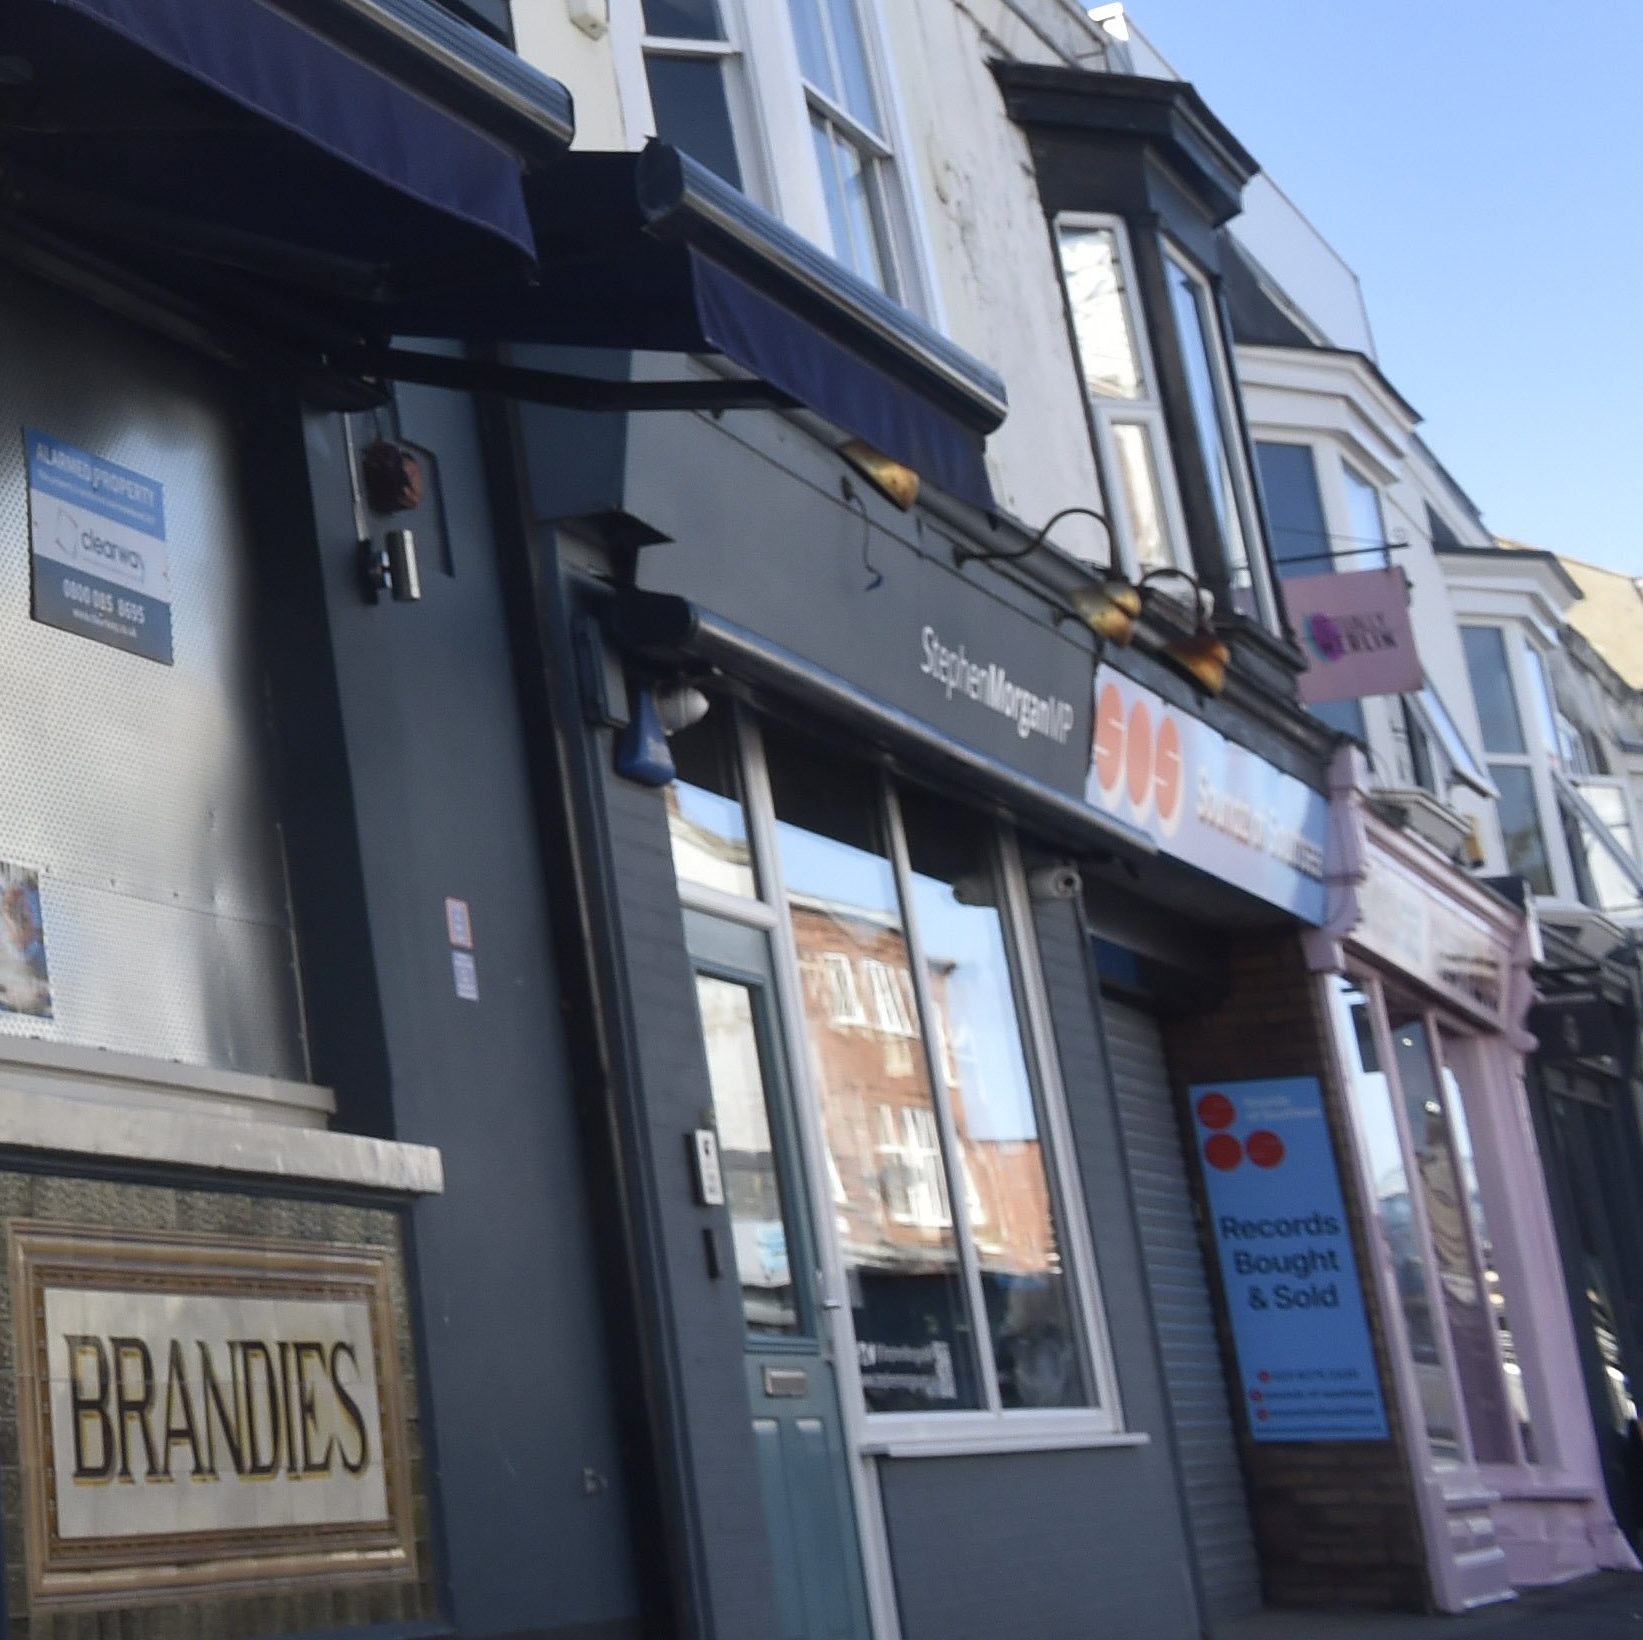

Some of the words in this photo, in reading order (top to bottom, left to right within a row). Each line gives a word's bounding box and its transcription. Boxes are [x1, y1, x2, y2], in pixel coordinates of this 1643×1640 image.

[1220, 1212, 1341, 1241] Records
[1233, 1246, 1340, 1280] Bought
[1248, 1286, 1269, 1310] &
[1273, 1282, 1339, 1310] Sold
[63, 1334, 371, 1487] BRANDIES
